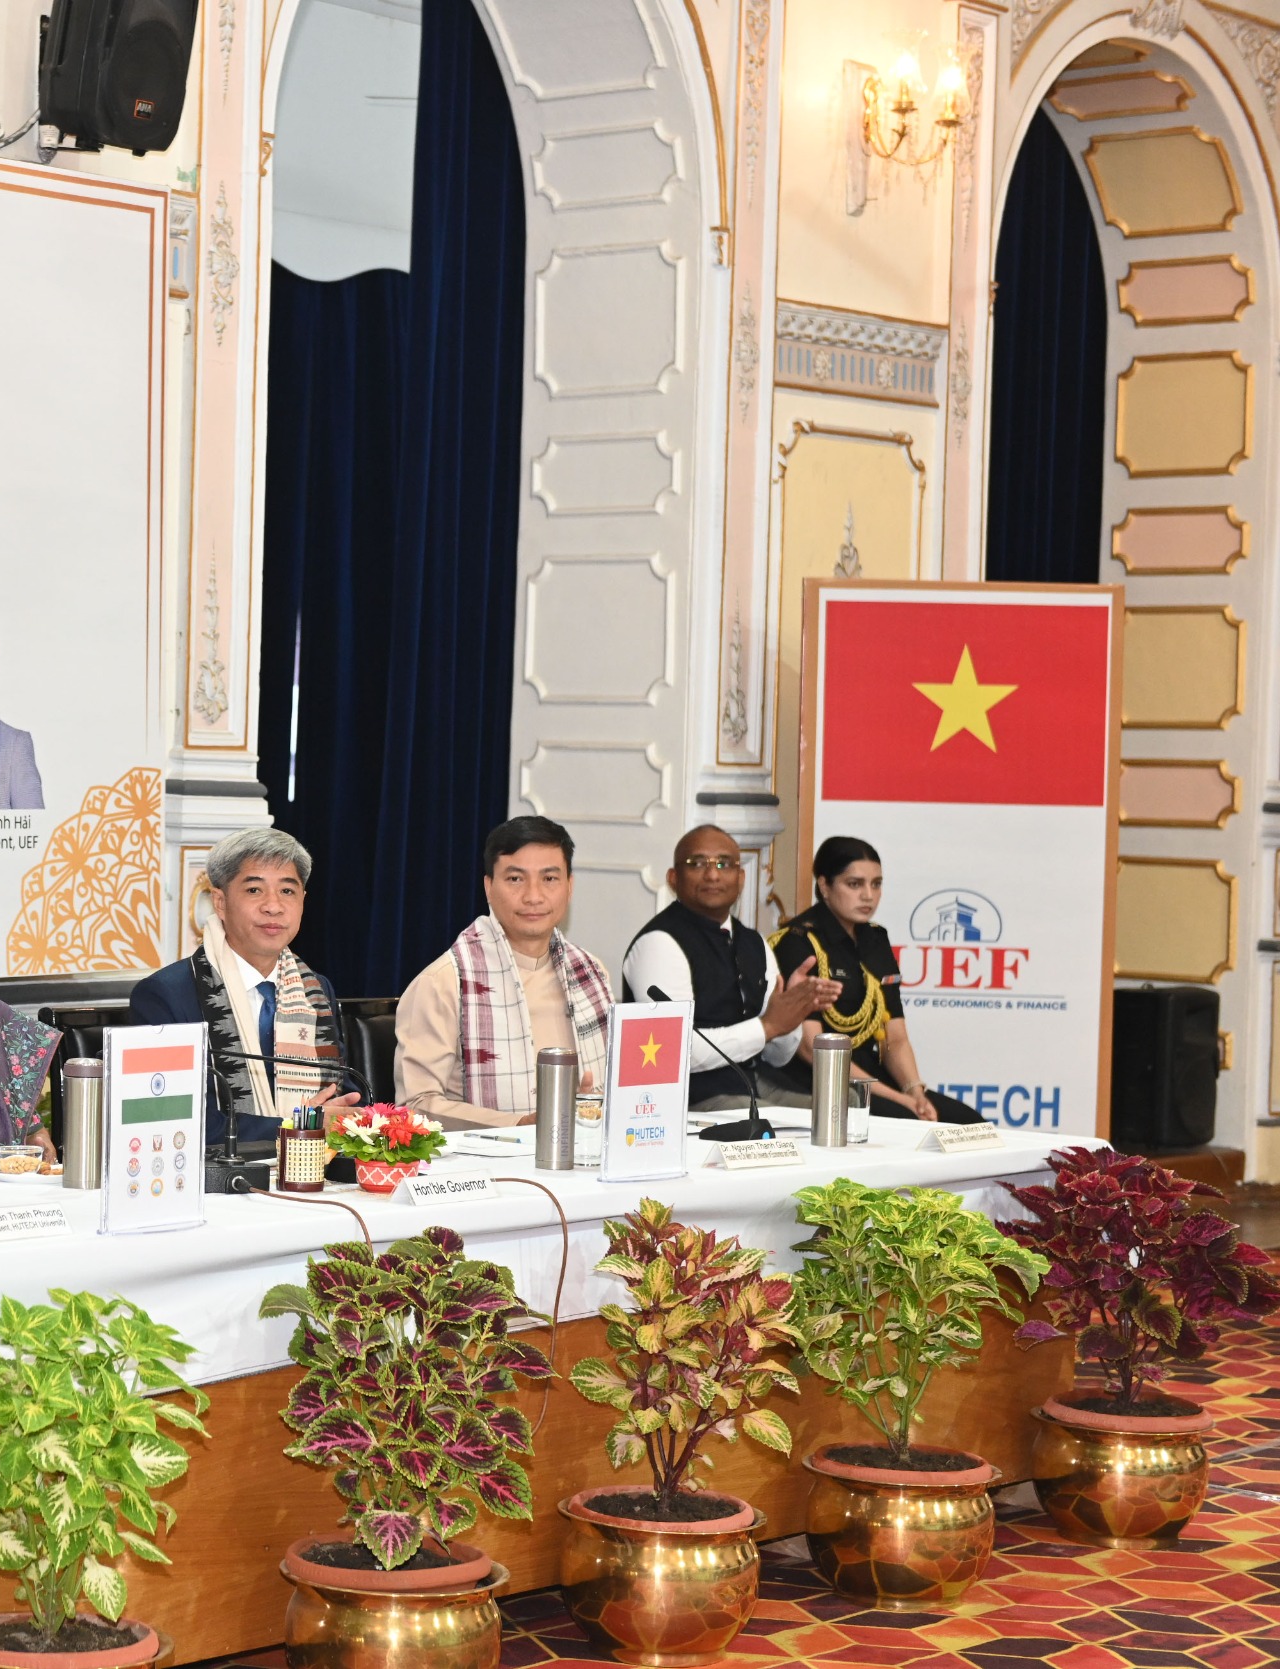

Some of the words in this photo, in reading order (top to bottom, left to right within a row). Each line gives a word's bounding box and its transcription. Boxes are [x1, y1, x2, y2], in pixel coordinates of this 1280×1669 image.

[19, 836, 38, 848] UEF
[913, 998, 930, 1007] OF
[932, 999, 1002, 1010] ECONOMICS
[1005, 1000, 1014, 1010] &
[1016, 1001, 1068, 1011] FINANCE
[635, 1103, 657, 1116] UEF
[938, 1084, 1060, 1128] TECH
[560, 1114, 570, 1157] INFINITY
[635, 1126, 665, 1140] HUTECH
[413, 1182, 447, 1196] Hon'ble
[446, 1179, 488, 1193] Governor
[8, 1210, 32, 1220] Thanh
[33, 1208, 64, 1218] Phuong
